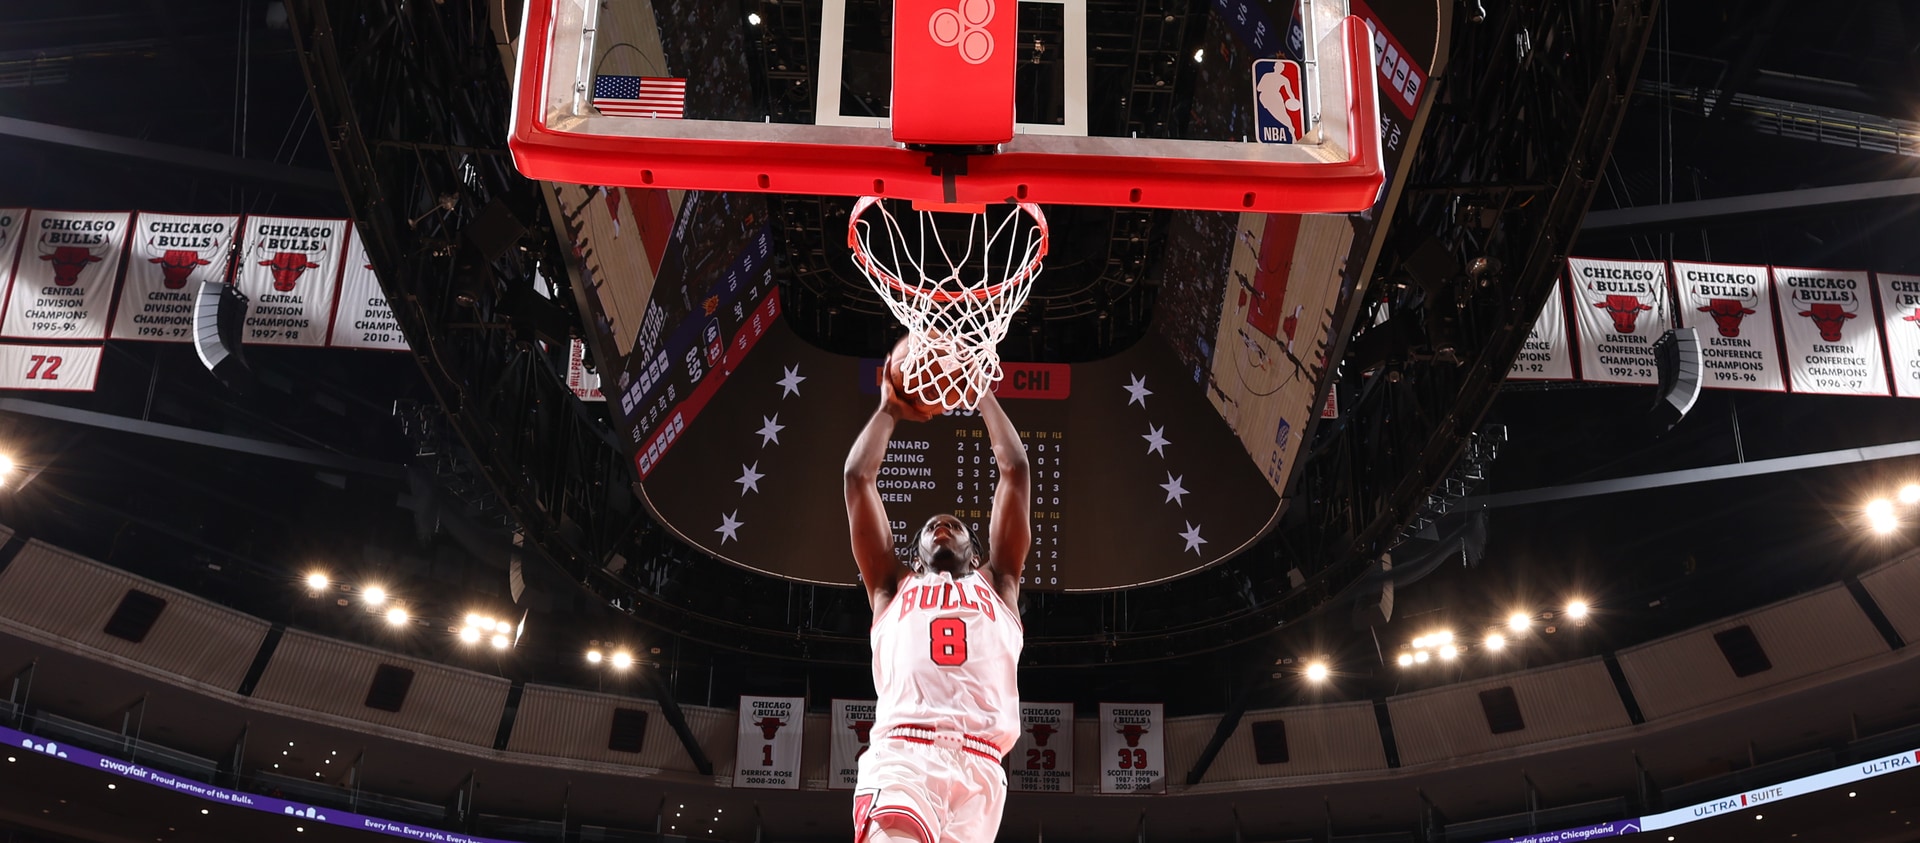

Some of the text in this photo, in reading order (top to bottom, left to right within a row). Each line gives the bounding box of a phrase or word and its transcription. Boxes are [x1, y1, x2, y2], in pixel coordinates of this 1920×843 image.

[1385, 56, 1394, 69] 2
[1387, 79, 1417, 151] TOV 10
[1263, 126, 1287, 142] NBA
[41, 218, 115, 231] CHICAGO
[150, 221, 224, 233] CHICAGO
[258, 224, 332, 238] CHICAGO
[49, 232, 102, 244] BULLS
[158, 236, 211, 248] BULLS
[267, 238, 320, 251] BULLS
[1583, 266, 1654, 281] CHICAGO
[1687, 271, 1756, 285] CHICAGO
[1596, 282, 1646, 293] BULLS
[1787, 276, 1857, 290] CHICAGO
[41, 286, 85, 296] CENTRAL
[148, 292, 193, 301] CENTRAL
[749, 285, 758, 301] FT
[1700, 285, 1749, 297] BULLS
[1800, 289, 1850, 301] BULLS
[36, 298, 83, 308] DIVISION
[260, 294, 303, 304] CENTRAL
[144, 304, 192, 313] DIVISION
[255, 306, 303, 316] DIVISION
[25, 310, 88, 320] CHAMPIONS
[246, 317, 309, 328] CHAMPIONS
[639, 298, 657, 352] BULLS
[707, 326, 720, 360] 48 33
[1606, 334, 1647, 344] EASTERN
[1710, 337, 1751, 347] EASTERN
[1598, 344, 1655, 355] CONFERENC
[1702, 348, 1763, 359] CONFERENCE
[1813, 344, 1854, 354] EASTERN
[685, 346, 703, 384] 8:59
[1704, 360, 1764, 371] CHAMPIONS
[1805, 355, 1867, 366] CONFERENCE
[26, 355, 63, 380] 72
[1808, 367, 1868, 377] CHAMPIONS
[1013, 370, 1050, 391] CHI
[631, 424, 642, 443] TOV
[888, 440, 930, 450] NNARD
[957, 442, 964, 451] 2
[974, 442, 980, 451] 1
[1038, 444, 1045, 452] 0
[1054, 444, 1060, 453] 1
[957, 455, 964, 464] 0
[973, 456, 980, 465] 0
[989, 456, 996, 465] 0
[1037, 457, 1044, 465] 0
[1054, 458, 1060, 466] 1
[957, 468, 964, 477] 5
[973, 469, 980, 478] 3
[989, 469, 996, 478] 2
[1038, 470, 1043, 479] 1
[1053, 471, 1060, 479] 0
[877, 480, 1060, 492] GHODARO 8 1 1 1 3
[881, 493, 1060, 505] REEN 6 1 0 0
[1036, 524, 1058, 532] 1 1
[1035, 537, 1057, 546] 2 1
[1036, 550, 1058, 559] 1 2
[1034, 576, 1057, 585] 0 0
[899, 582, 996, 622] BULLS
[930, 617, 968, 667] 8
[752, 701, 791, 710] CHICAGO
[757, 709, 786, 717] BULLS
[1022, 708, 1061, 716] CHICAGO
[1112, 708, 1151, 717] CHICAGO
[1028, 716, 1056, 724] BULLS
[1118, 716, 1146, 724] BULLS
[762, 744, 773, 767] 1
[1026, 748, 1056, 770] 23
[1117, 748, 1148, 769] 33
[1862, 756, 1911, 775] ULTRA
[741, 769, 793, 778] DERRICK ROSE
[1012, 769, 1040, 777] MICHAEL
[1107, 769, 1133, 777] SCOTTIE
[109, 761, 254, 805] wayfair Proud partner of the Bulls.
[746, 777, 786, 785] 2008-2016
[1694, 787, 1783, 817] ULTRA SUITE
[364, 819, 387, 831] Every
[387, 823, 402, 833] fan.
[403, 826, 425, 838] Every
[1539, 824, 1614, 843] store Chicagoland
